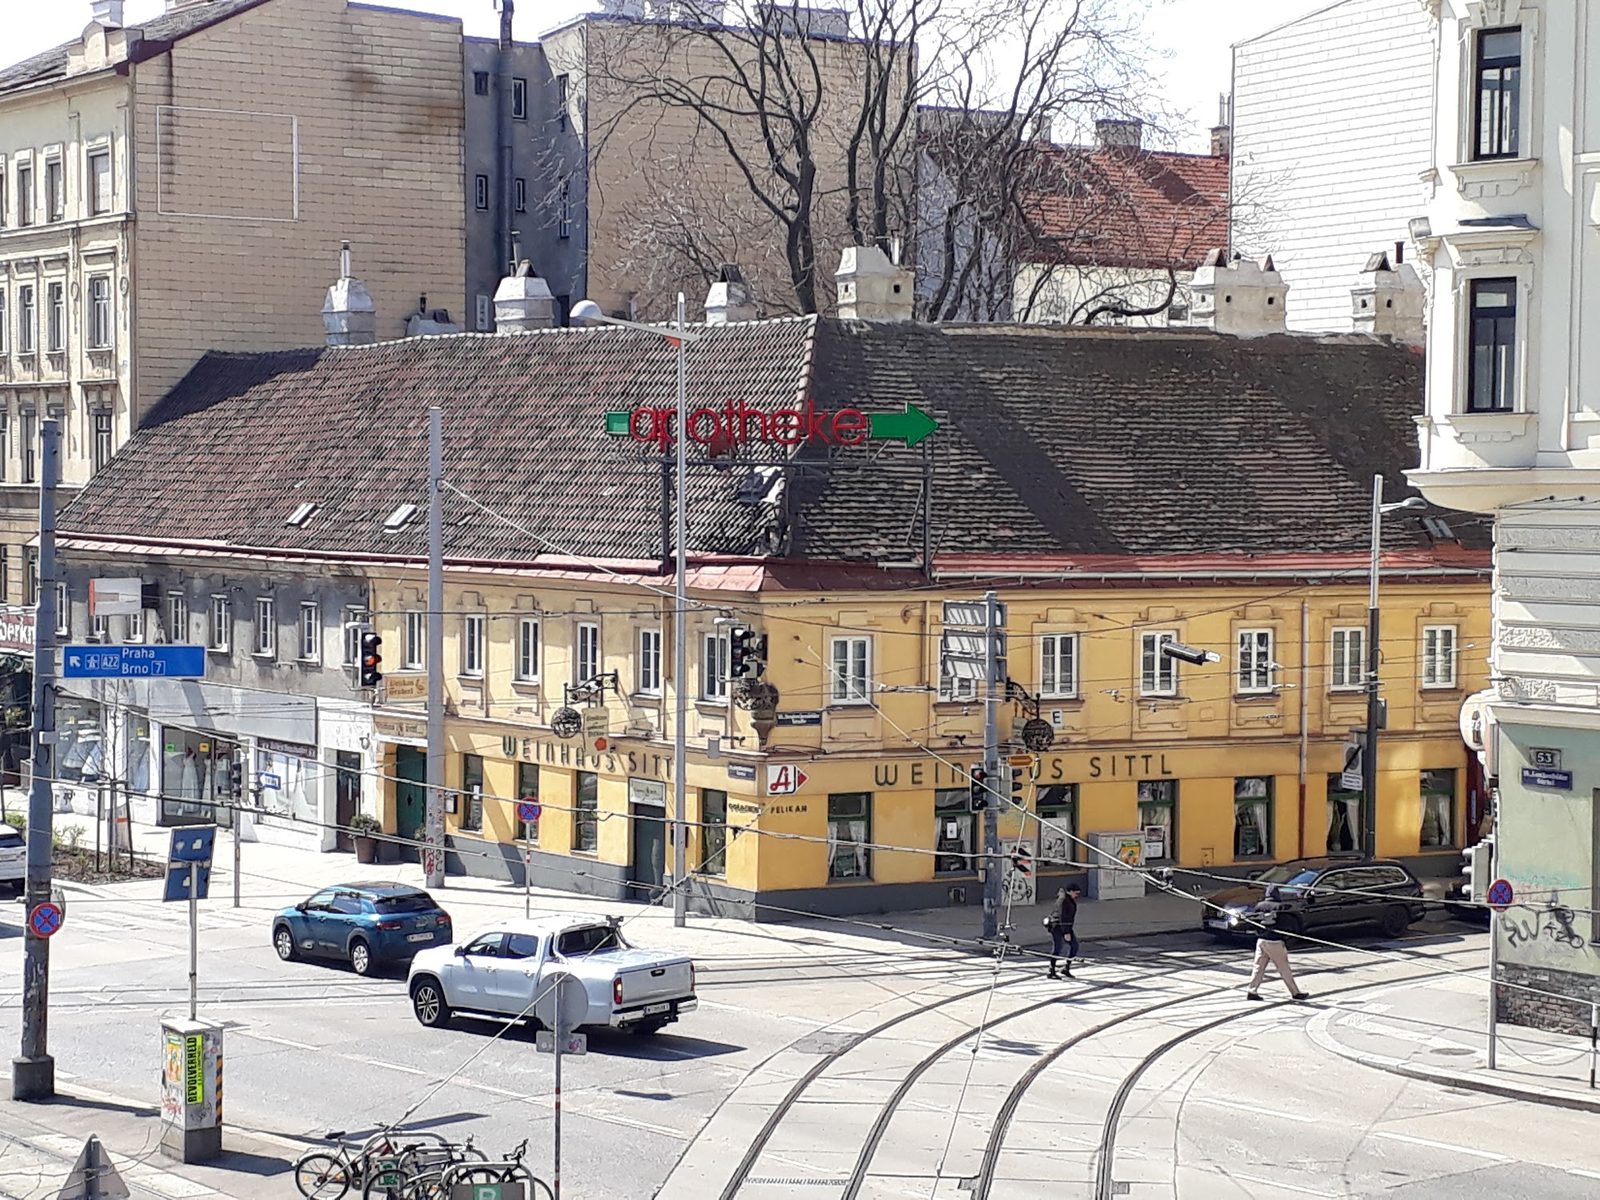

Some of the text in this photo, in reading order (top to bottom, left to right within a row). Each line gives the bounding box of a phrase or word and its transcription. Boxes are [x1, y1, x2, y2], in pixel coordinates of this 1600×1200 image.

[630, 399, 867, 450] apotheke
[122, 647, 155, 659] Praha
[102, 655, 119, 668] A22
[122, 663, 162, 674] Brno 7
[1052, 711, 1061, 724] E
[503, 735, 672, 780] WEINHAUS SITT
[1537, 752, 1552, 764] 53
[875, 754, 1173, 786] WEINUS SITTL
[770, 805, 807, 814] PELIKAN
[187, 1037, 198, 1102] REVOLVERHELD
